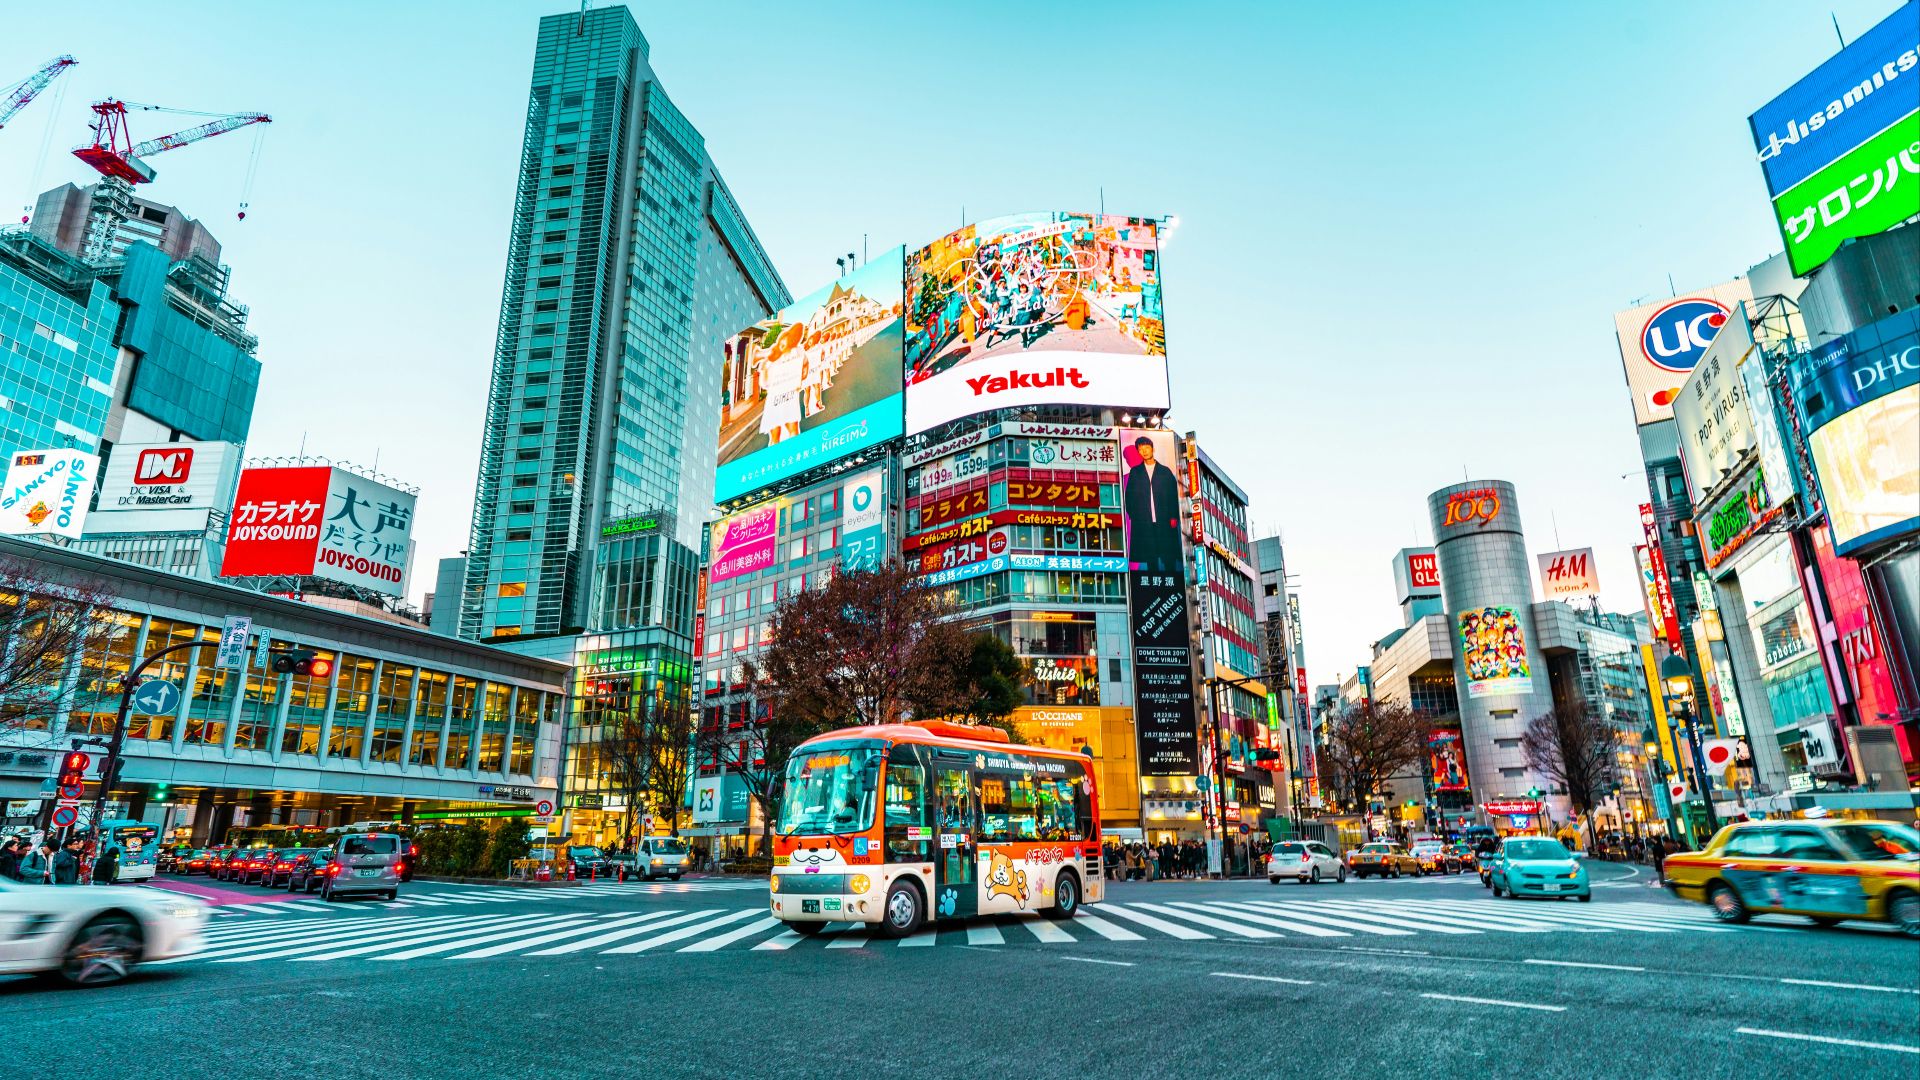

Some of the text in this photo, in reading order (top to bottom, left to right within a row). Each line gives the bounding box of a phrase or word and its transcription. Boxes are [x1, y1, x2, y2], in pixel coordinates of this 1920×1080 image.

[1756, 45, 1920, 162] Hisamits
[1811, 344, 1849, 371] Channel
[1852, 345, 1920, 392] DHC
[966, 367, 1090, 396] Yakult
[821, 425, 869, 452] KIREIMO
[1020, 423, 1114, 437] しゃぶしゃぶバイキング
[1059, 444, 1114, 463] しゃぶ葉
[2, 460, 67, 510] SANKYO
[130, 486, 146, 495] DC
[148, 485, 171, 495] VISA
[908, 476, 920, 488] 9F
[1008, 484, 1097, 501] コンタクト
[57, 458, 88, 528] SANKYO
[118, 494, 192, 505] DC MasterCard
[236, 500, 320, 523] カラオケ
[327, 486, 411, 534] 大声
[922, 490, 987, 523] プライス
[847, 510, 878, 526] eyecity
[232, 524, 318, 541] JOYSOUND
[318, 547, 402, 583] JOYSOUND
[719, 552, 771, 576] 品川美容外科
[942, 541, 984, 568] ガスト
[1047, 556, 1126, 570] 英会話イーオン
[1547, 553, 1587, 583] H&M
[1140, 576, 1175, 586] 星野源
[1554, 584, 1580, 592] 150m
[227, 621, 247, 665] 渋谷駅前
[1032, 711, 1083, 721] L'OCCITANE
[987, 758, 1010, 769] SHIBUYA
[1010, 760, 1036, 773] community
[1259, 784, 1275, 803] LUSH
[1025, 846, 1064, 865] ハチ公バス
